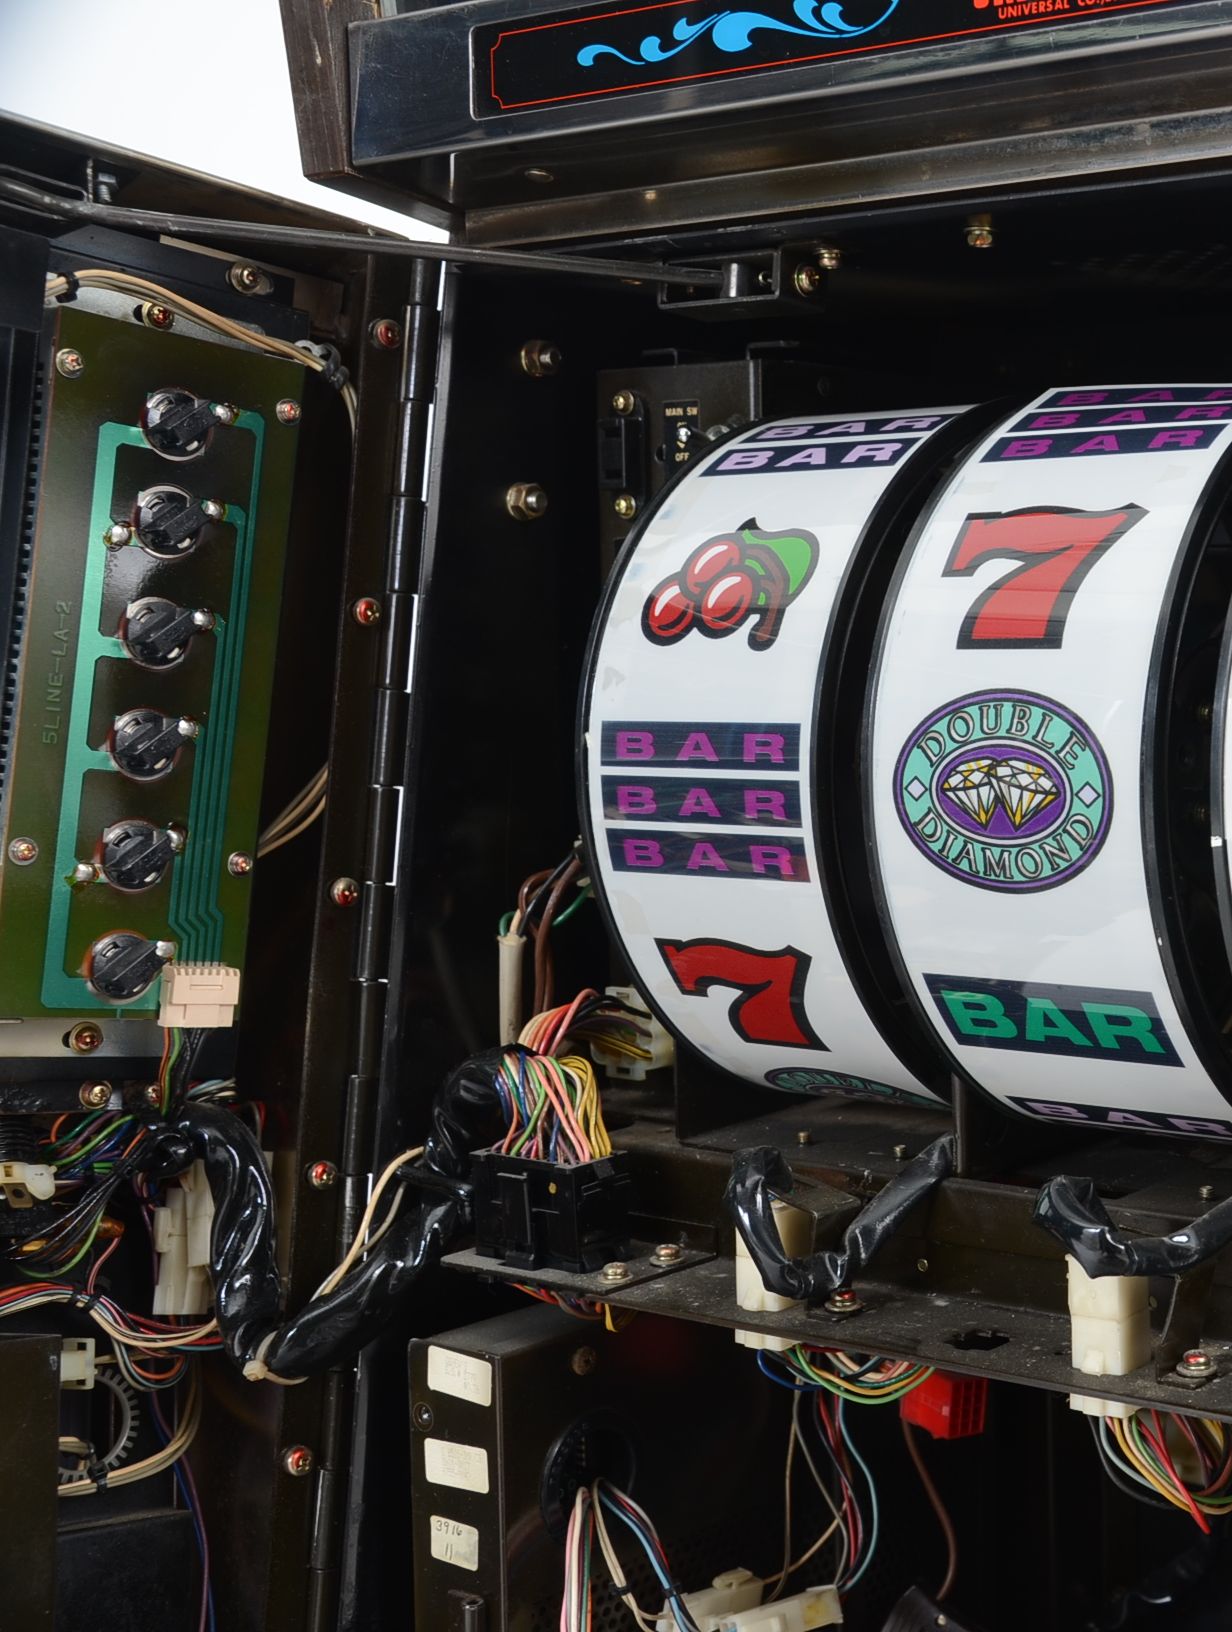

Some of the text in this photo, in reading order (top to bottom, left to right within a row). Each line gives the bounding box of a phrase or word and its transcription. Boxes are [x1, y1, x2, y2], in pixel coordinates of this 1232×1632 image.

[998, 0, 1070, 19] UNIVERSAL
[665, 406, 698, 416] MAIN SW
[1027, 405, 1232, 429] BAR
[755, 416, 942, 440] BAR
[999, 429, 1204, 458] BAR
[674, 452, 690, 462] OFF
[715, 442, 904, 471] BAR
[940, 502, 1150, 650] 7
[615, 730, 785, 763] BAR
[917, 703, 1088, 771] DOUBLE
[615, 785, 787, 820] BAR
[622, 838, 795, 875] BAR
[912, 806, 1095, 880] DIAMOND
[653, 937, 832, 1052] 7
[940, 989, 1166, 1054] BAR
